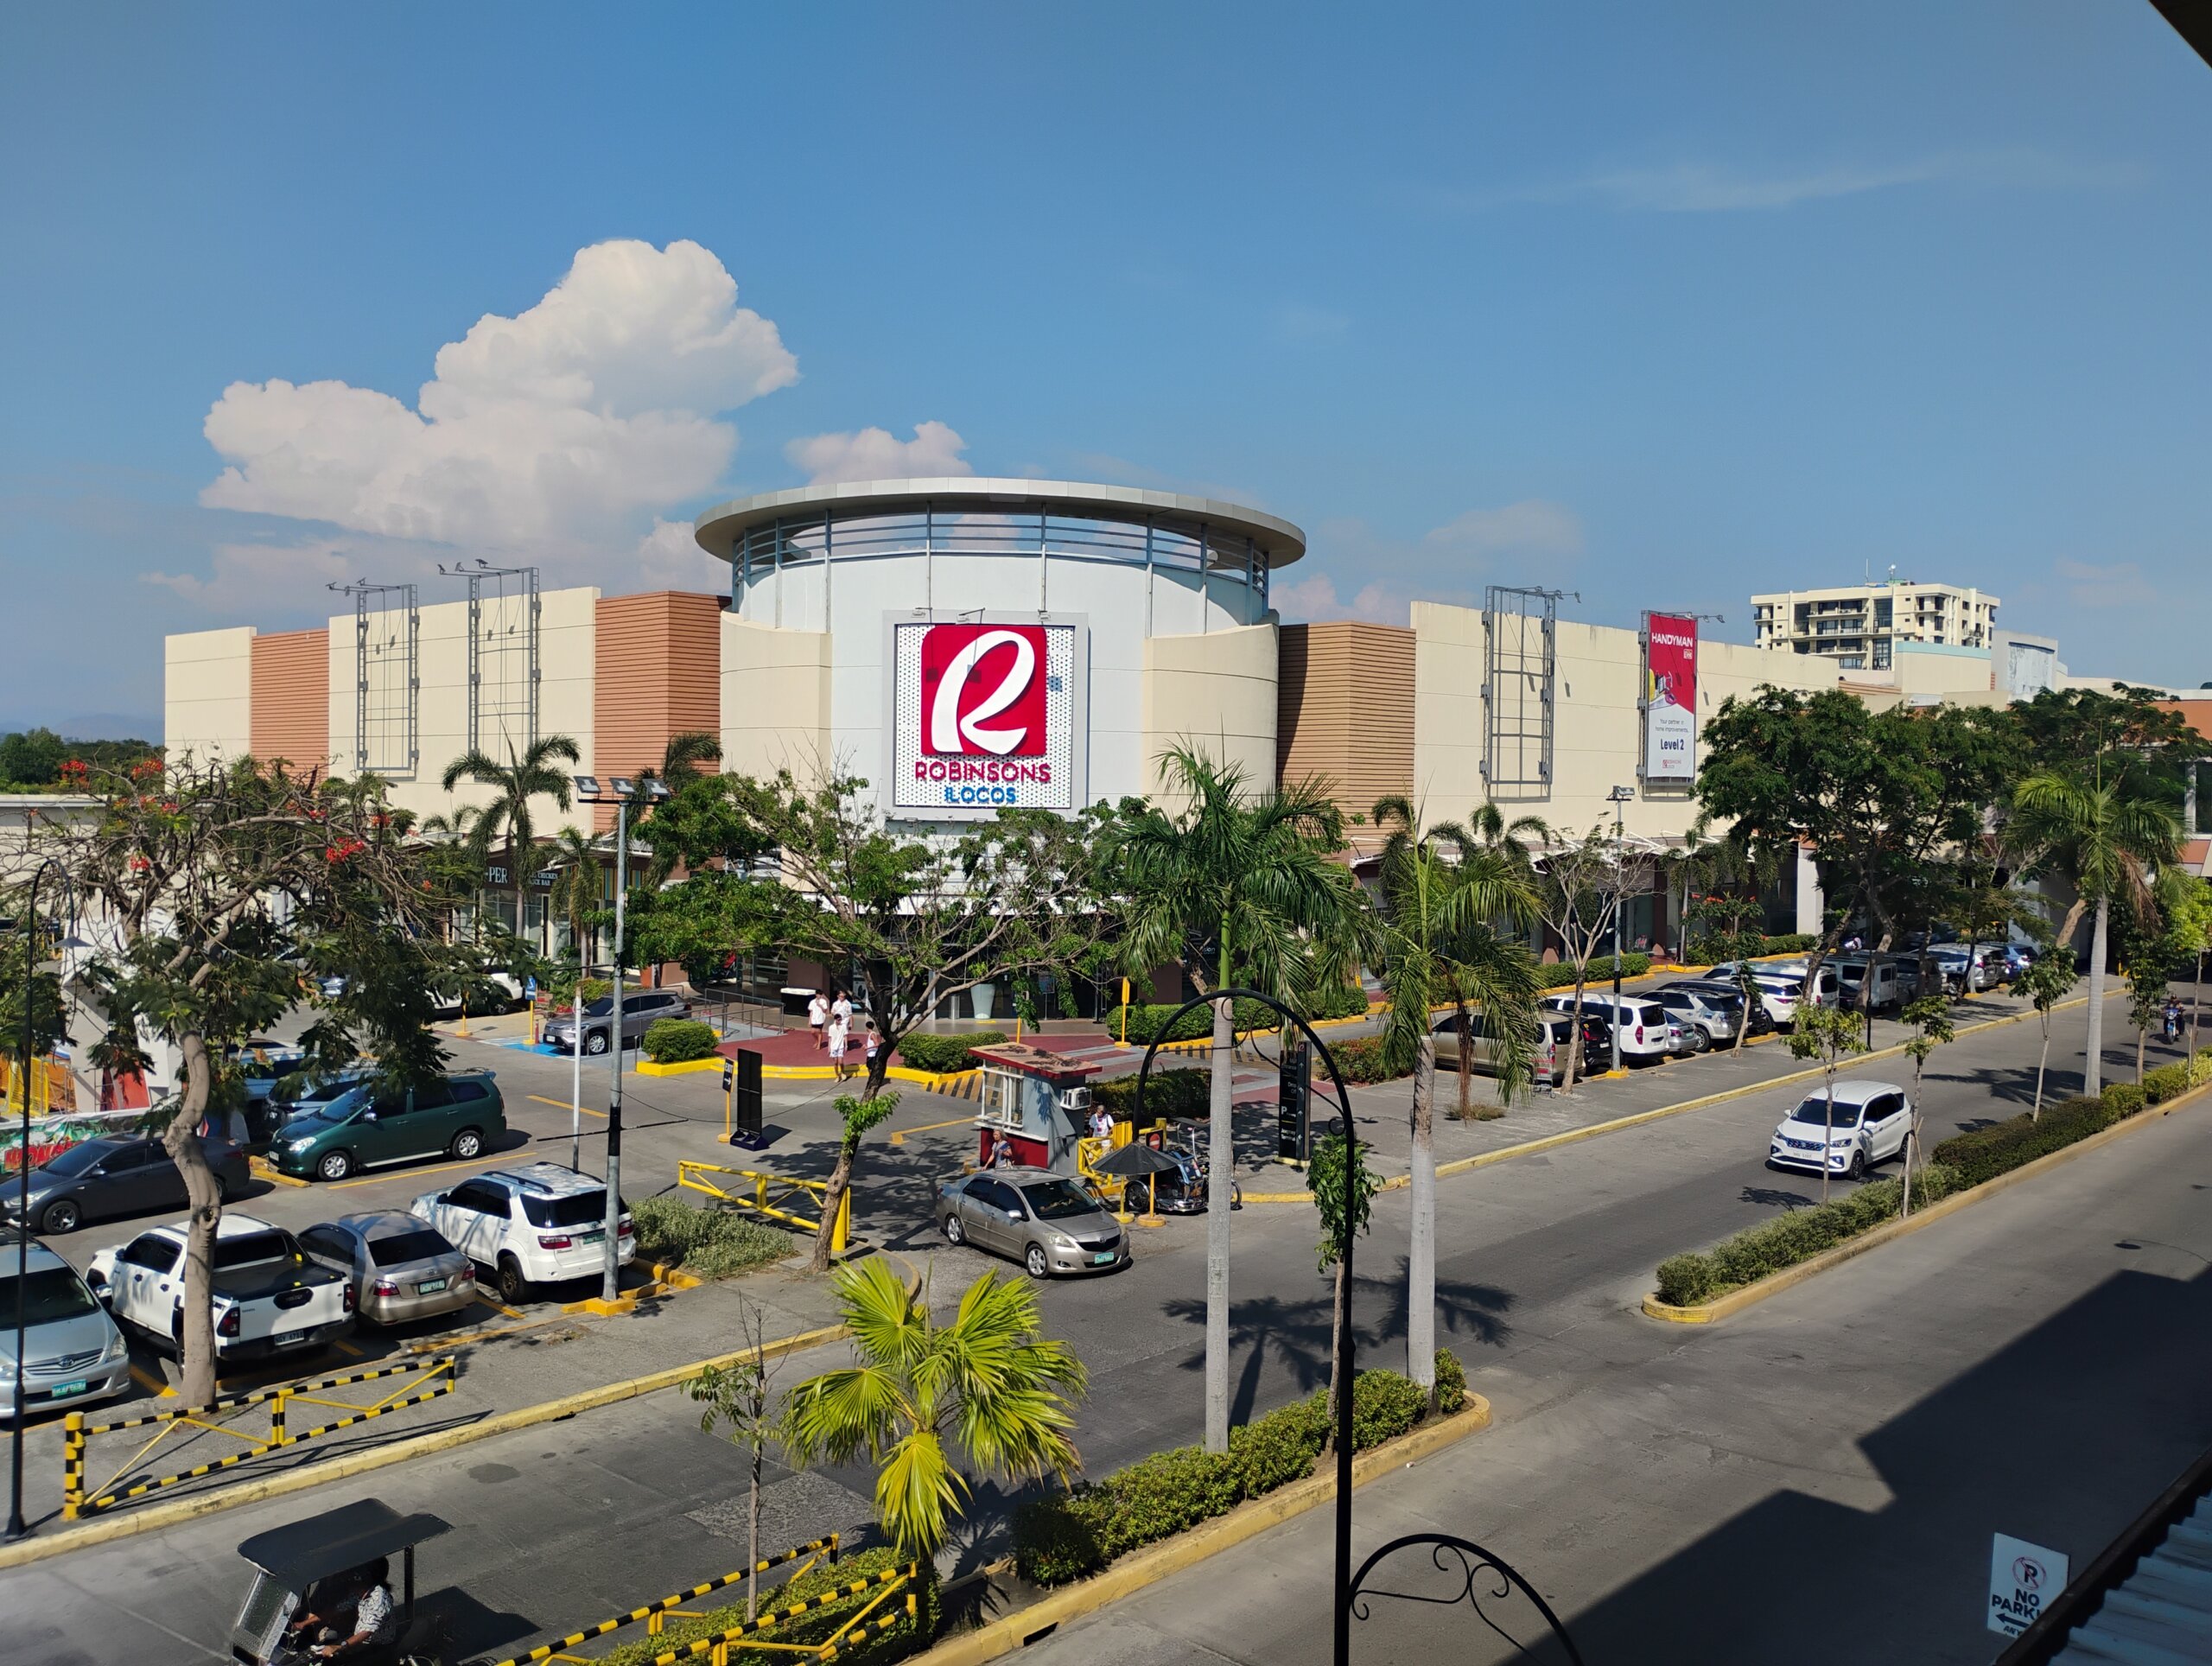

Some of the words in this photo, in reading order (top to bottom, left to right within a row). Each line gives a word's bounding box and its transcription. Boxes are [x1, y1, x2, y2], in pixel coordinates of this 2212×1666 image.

[1651, 632, 1694, 648] HANDYMAN
[1660, 738, 1679, 750] Level
[1680, 739, 1684, 750] 2
[915, 760, 1052, 783] ROBINSONS
[944, 785, 1017, 804] ILOCOS
[1281, 1105, 1287, 1115] P
[2015, 1587, 2040, 1607] NO
